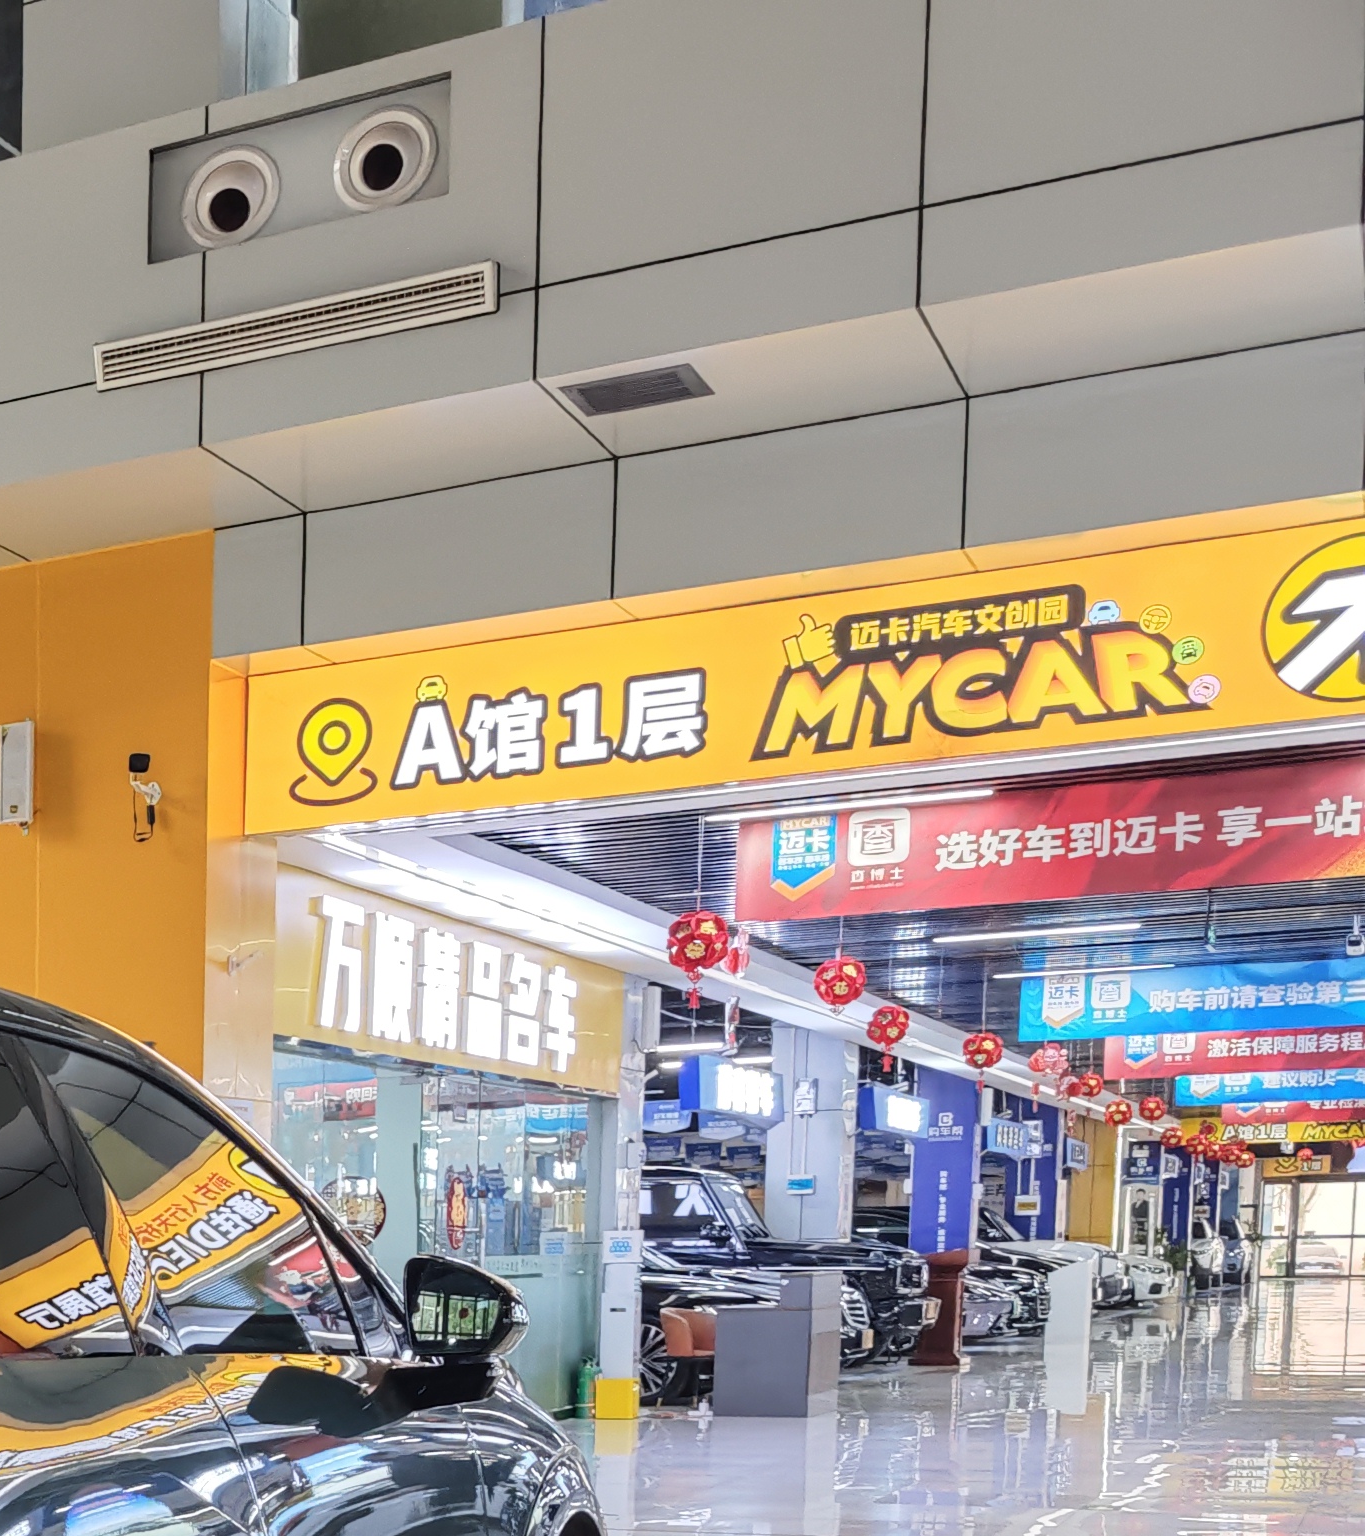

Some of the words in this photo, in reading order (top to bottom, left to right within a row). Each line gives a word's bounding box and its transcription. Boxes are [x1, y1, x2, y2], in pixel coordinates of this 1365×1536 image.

[849, 599, 1069, 650] 迈卡汽车文创园
[761, 632, 1177, 758] MYCAR
[391, 672, 707, 790] A馆1层
[779, 829, 832, 855] 迈卡
[935, 811, 1205, 871] 选好车到迈卡
[1216, 795, 1364, 847] 享一站
[1048, 985, 1080, 999] 迈卡
[1149, 981, 1365, 1013] 购车前请查验第三
[1207, 1032, 1363, 1058] 激活保障服务程
[1221, 1123, 1287, 1141] A馆1层
